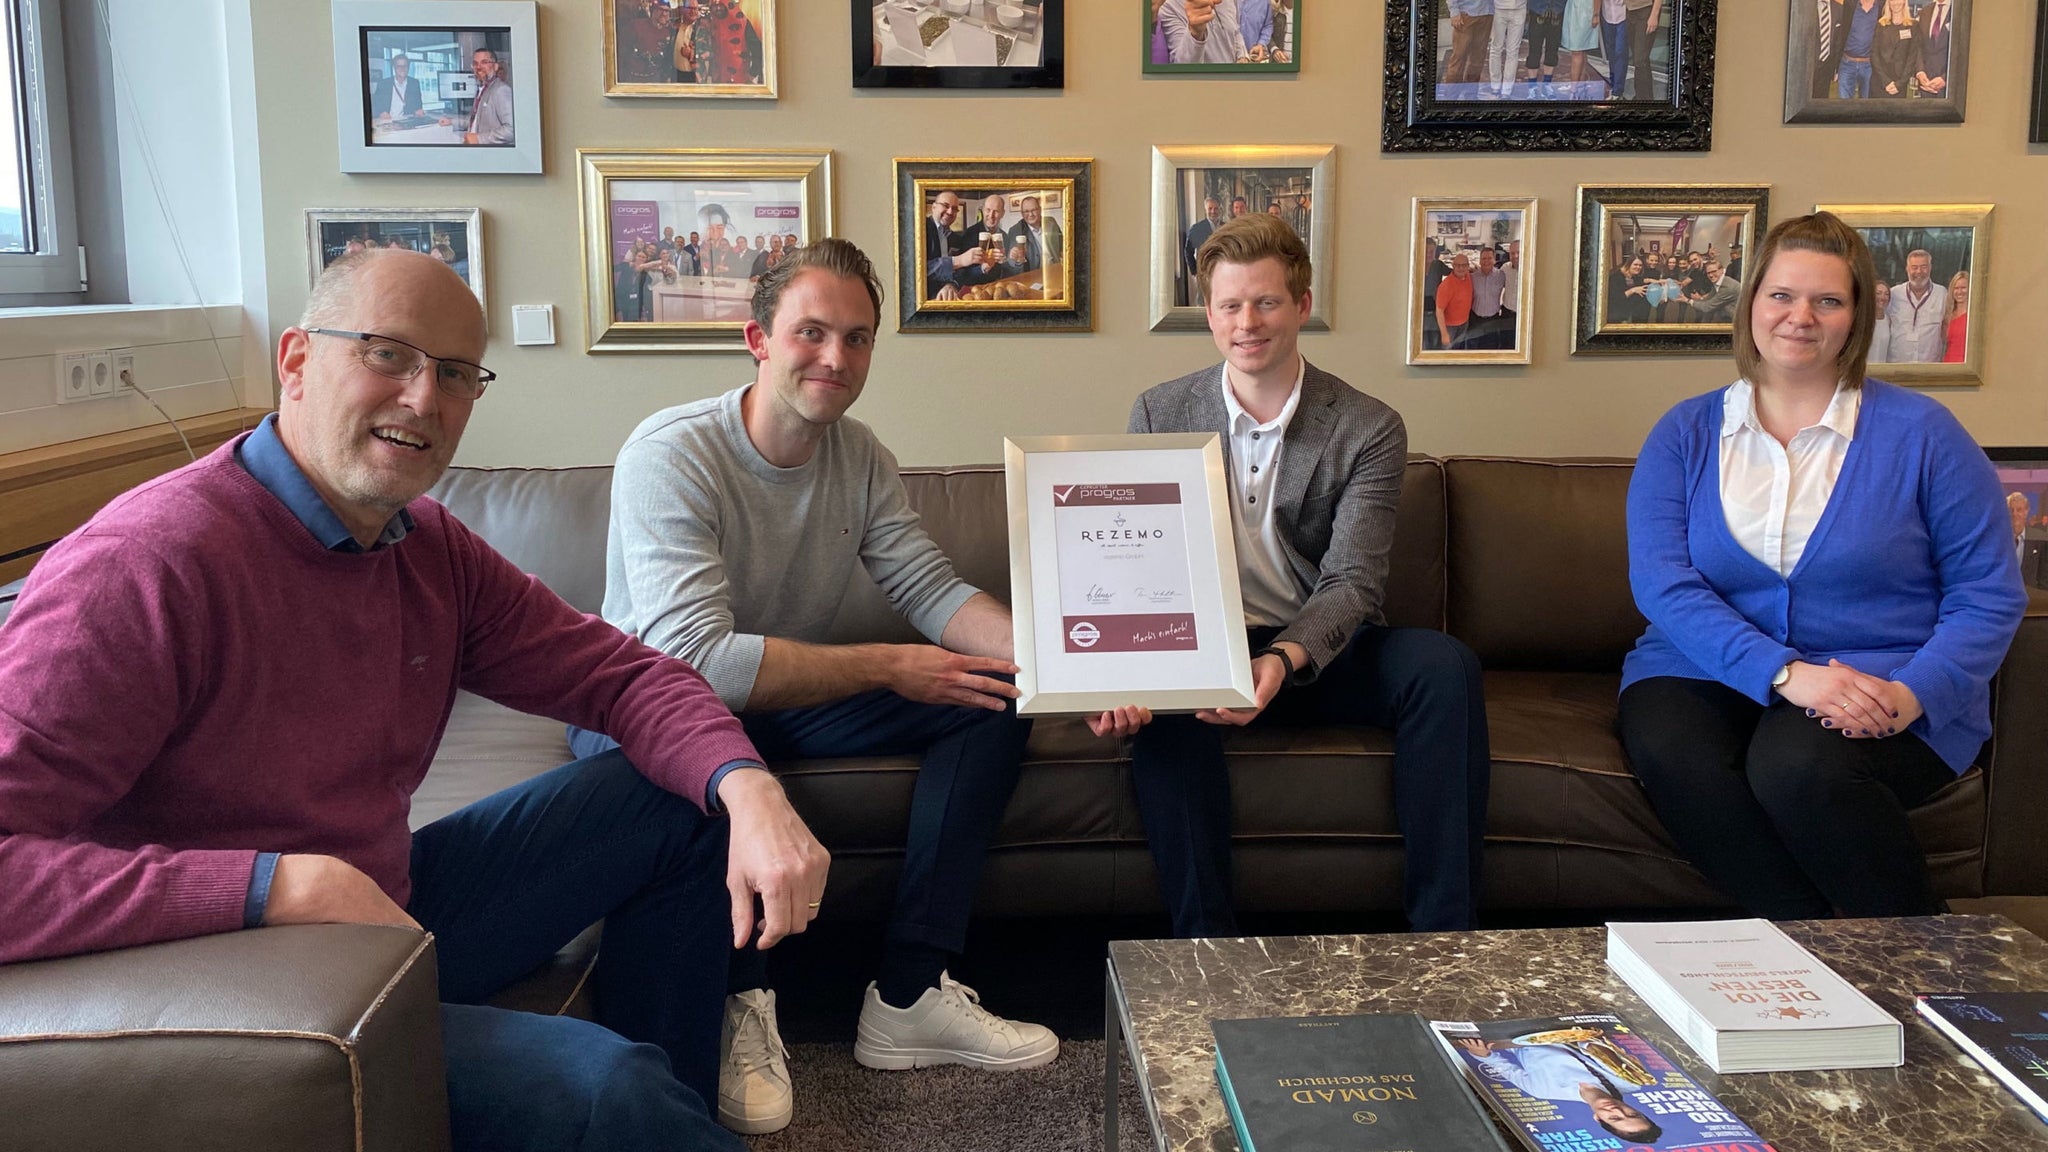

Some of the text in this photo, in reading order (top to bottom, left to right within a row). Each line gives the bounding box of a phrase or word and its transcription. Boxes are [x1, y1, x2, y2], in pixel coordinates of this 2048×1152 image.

[1080, 488, 1136, 499] progros
[1081, 529, 1163, 542] REZEMO
[1679, 968, 1812, 978] HOTELS DEUTSCHLANDS
[1723, 990, 1822, 1004] DIE 101
[1277, 1074, 1415, 1087] DAS KOCHBUCH
[1291, 1086, 1418, 1104] NOMAD
[1631, 1090, 1711, 1104] KÖCHE
[1647, 1100, 1723, 1114] BESTE
[1687, 1111, 1736, 1123] 100
[1533, 1129, 1592, 1143] STAR
